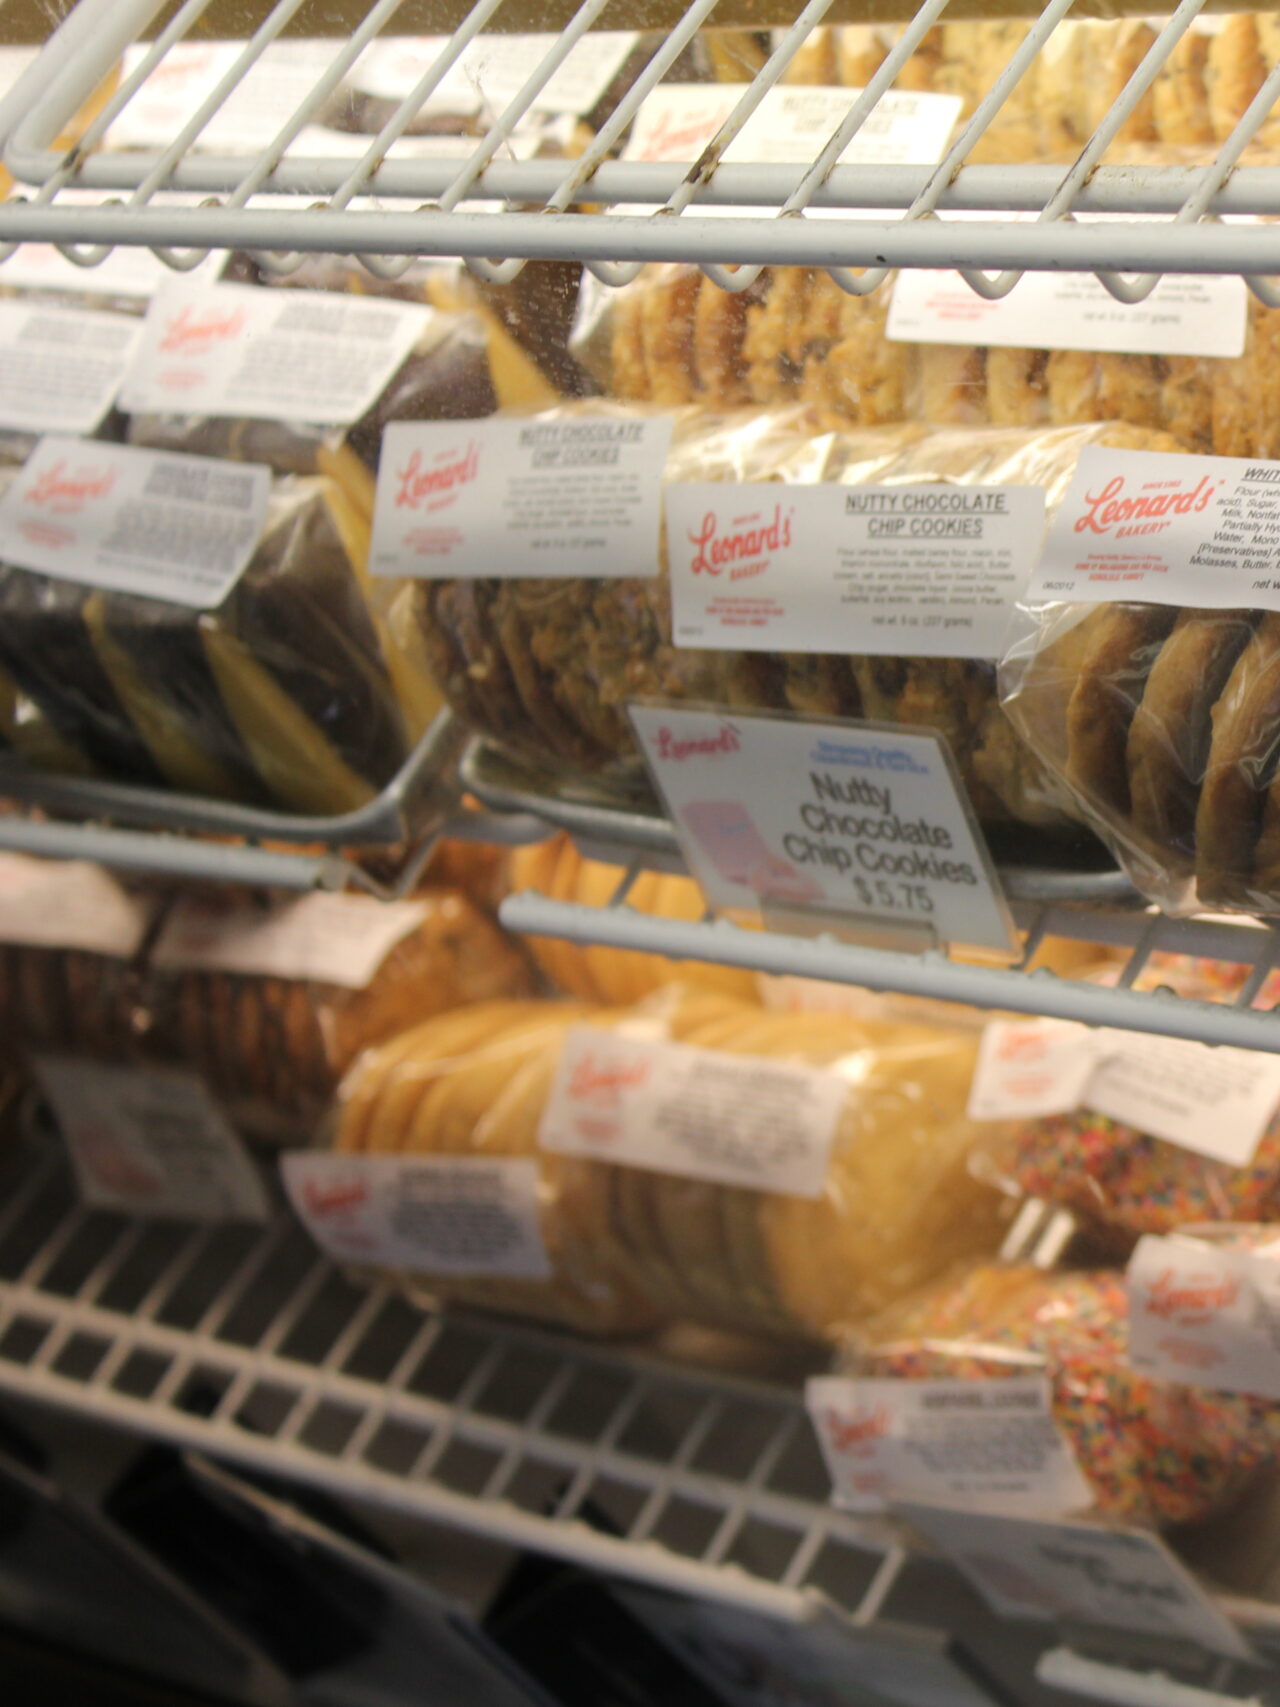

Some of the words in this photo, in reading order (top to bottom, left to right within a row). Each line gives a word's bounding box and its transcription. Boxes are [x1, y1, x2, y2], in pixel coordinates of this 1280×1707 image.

[1234, 486, 1261, 496] Flour
[846, 494, 899, 511] NUTTY
[902, 493, 1006, 511] CHOCOLATE
[1073, 475, 1216, 534] Leonard's
[1221, 508, 1243, 518] Milk,
[1247, 509, 1280, 520] Nonfat
[867, 518, 906, 536] CHIP
[909, 518, 983, 536] COOKIES
[1115, 522, 1166, 539] BAKERY
[1222, 519, 1263, 533] Partially
[1213, 531, 1244, 543] Water,
[1250, 535, 1279, 545] Mono
[1197, 542, 1272, 559] [Preservatives]
[1189, 555, 1238, 569] Molasses,
[1241, 558, 1273, 570] Butter,
[1252, 579, 1271, 591] net
[809, 772, 891, 814] Nutty
[801, 803, 953, 850] Chocolate
[783, 833, 851, 873] Chip
[855, 844, 978, 886] Cookies
